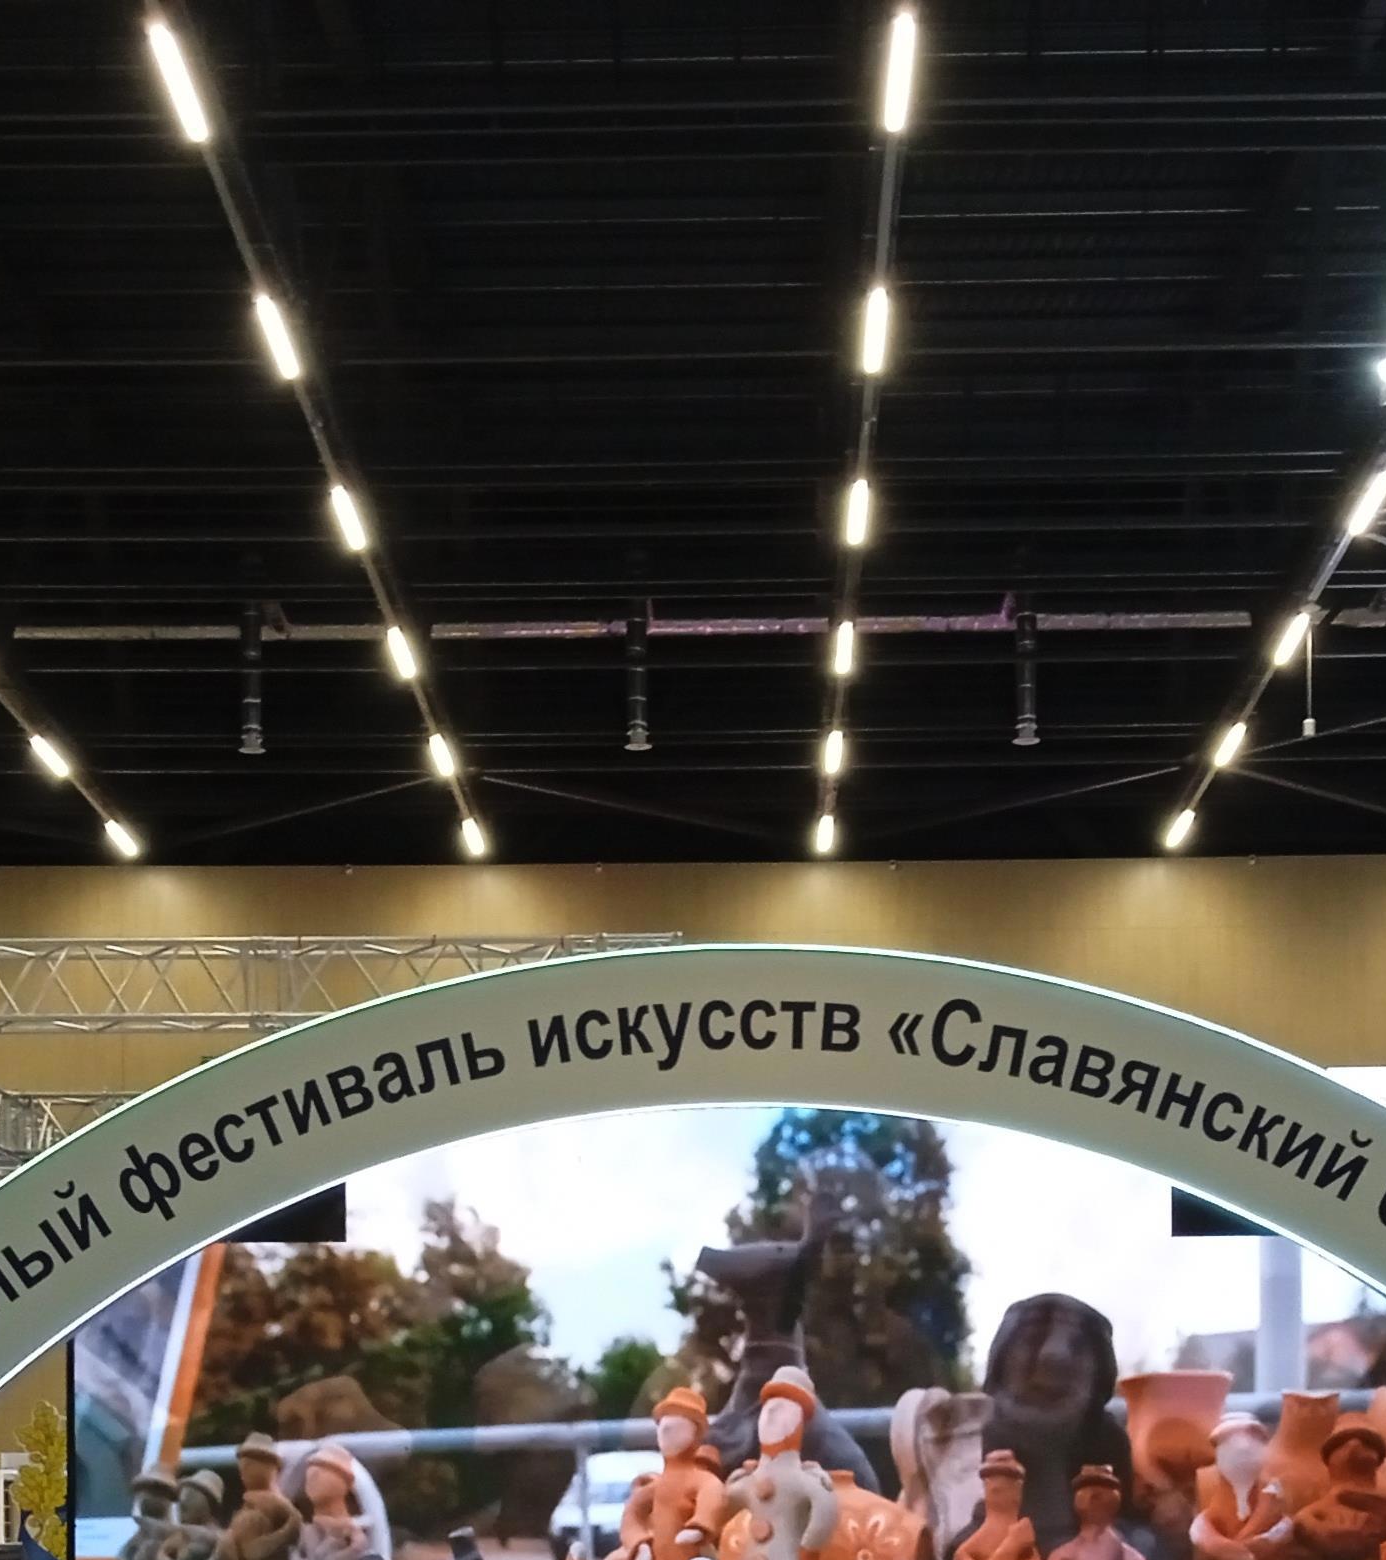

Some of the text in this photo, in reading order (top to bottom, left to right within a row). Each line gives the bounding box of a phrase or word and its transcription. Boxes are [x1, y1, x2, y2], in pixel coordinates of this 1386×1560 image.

[118, 1031, 507, 1221] фестиваль
[528, 999, 861, 1071] искусств
[888, 998, 1373, 1201] «Славянский
